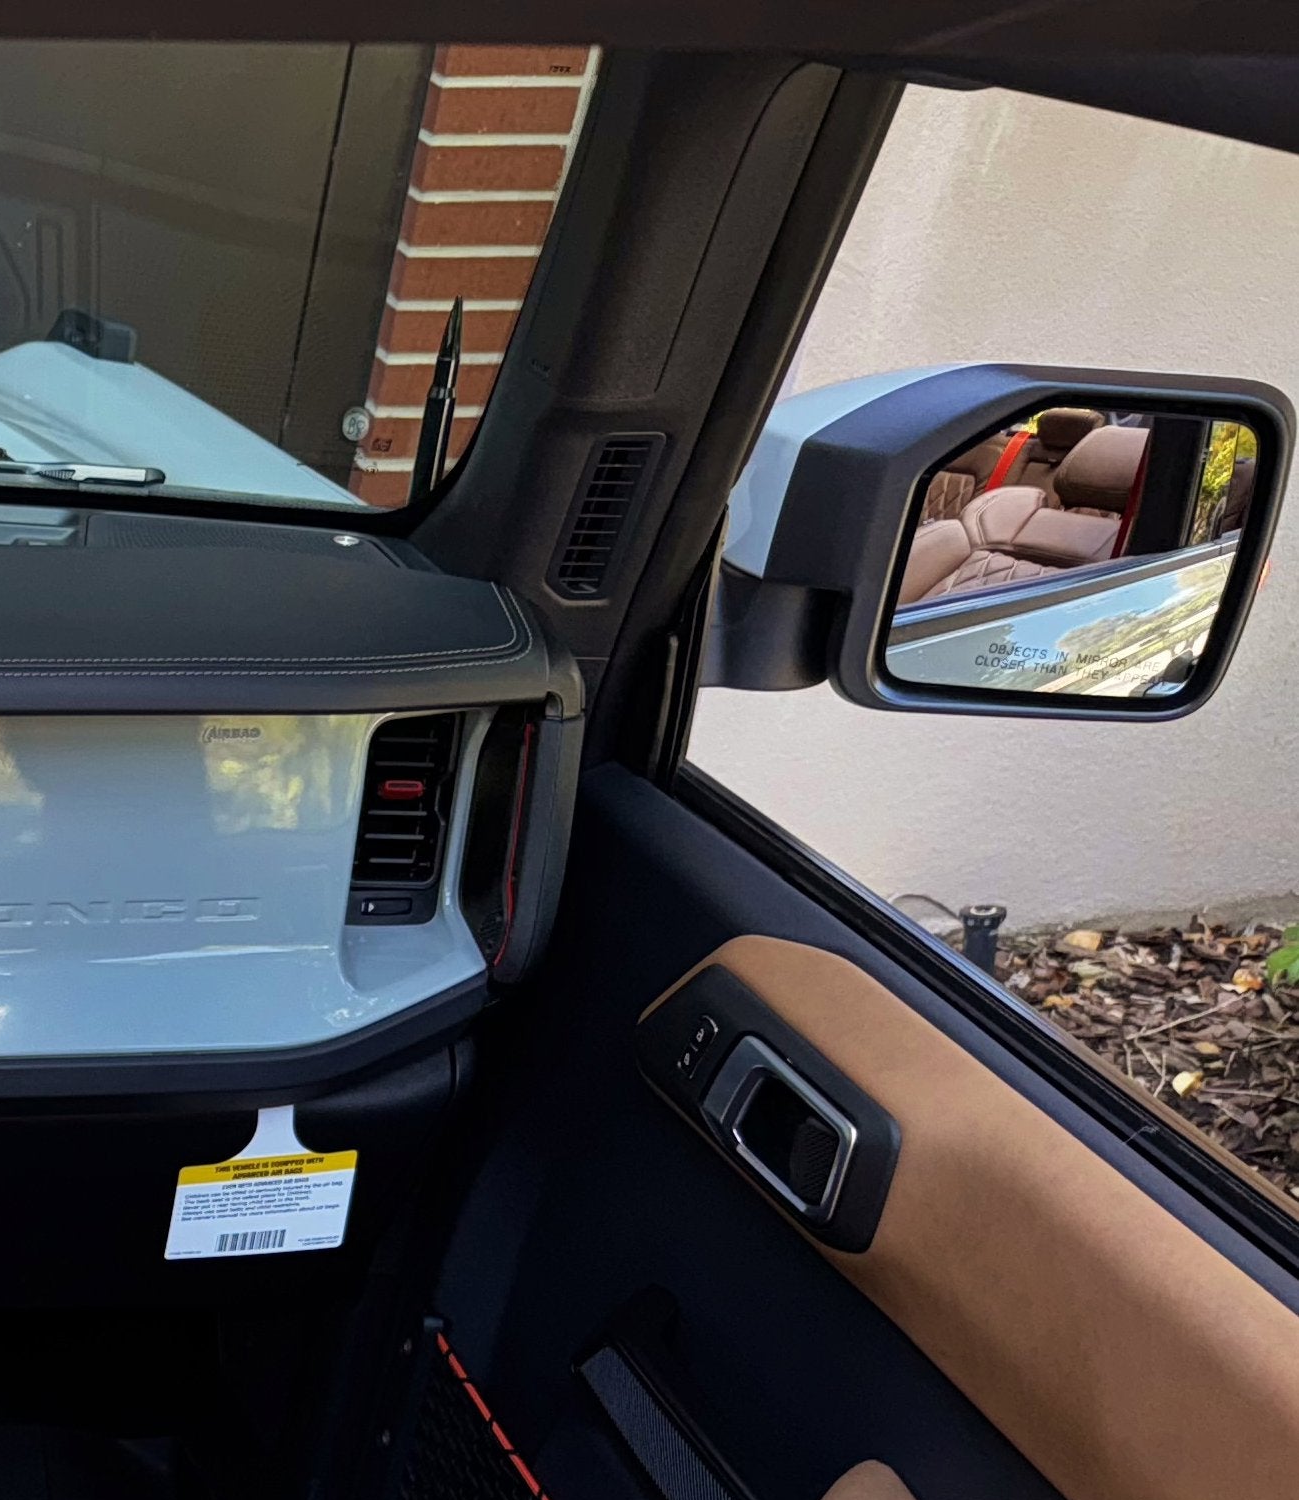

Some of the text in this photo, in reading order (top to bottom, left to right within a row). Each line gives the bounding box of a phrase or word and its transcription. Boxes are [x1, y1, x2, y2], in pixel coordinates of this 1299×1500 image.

[988, 642, 1161, 673] OBJECTS IN MIRROR ARE
[975, 655, 1025, 671] CLOSER
[1034, 662, 1067, 676] THAN
[1077, 668, 1110, 681] THEY
[232, 1162, 260, 1172] VEHICLE
[270, 1169, 283, 1177] AIR
[284, 1167, 303, 1175] BAGS
